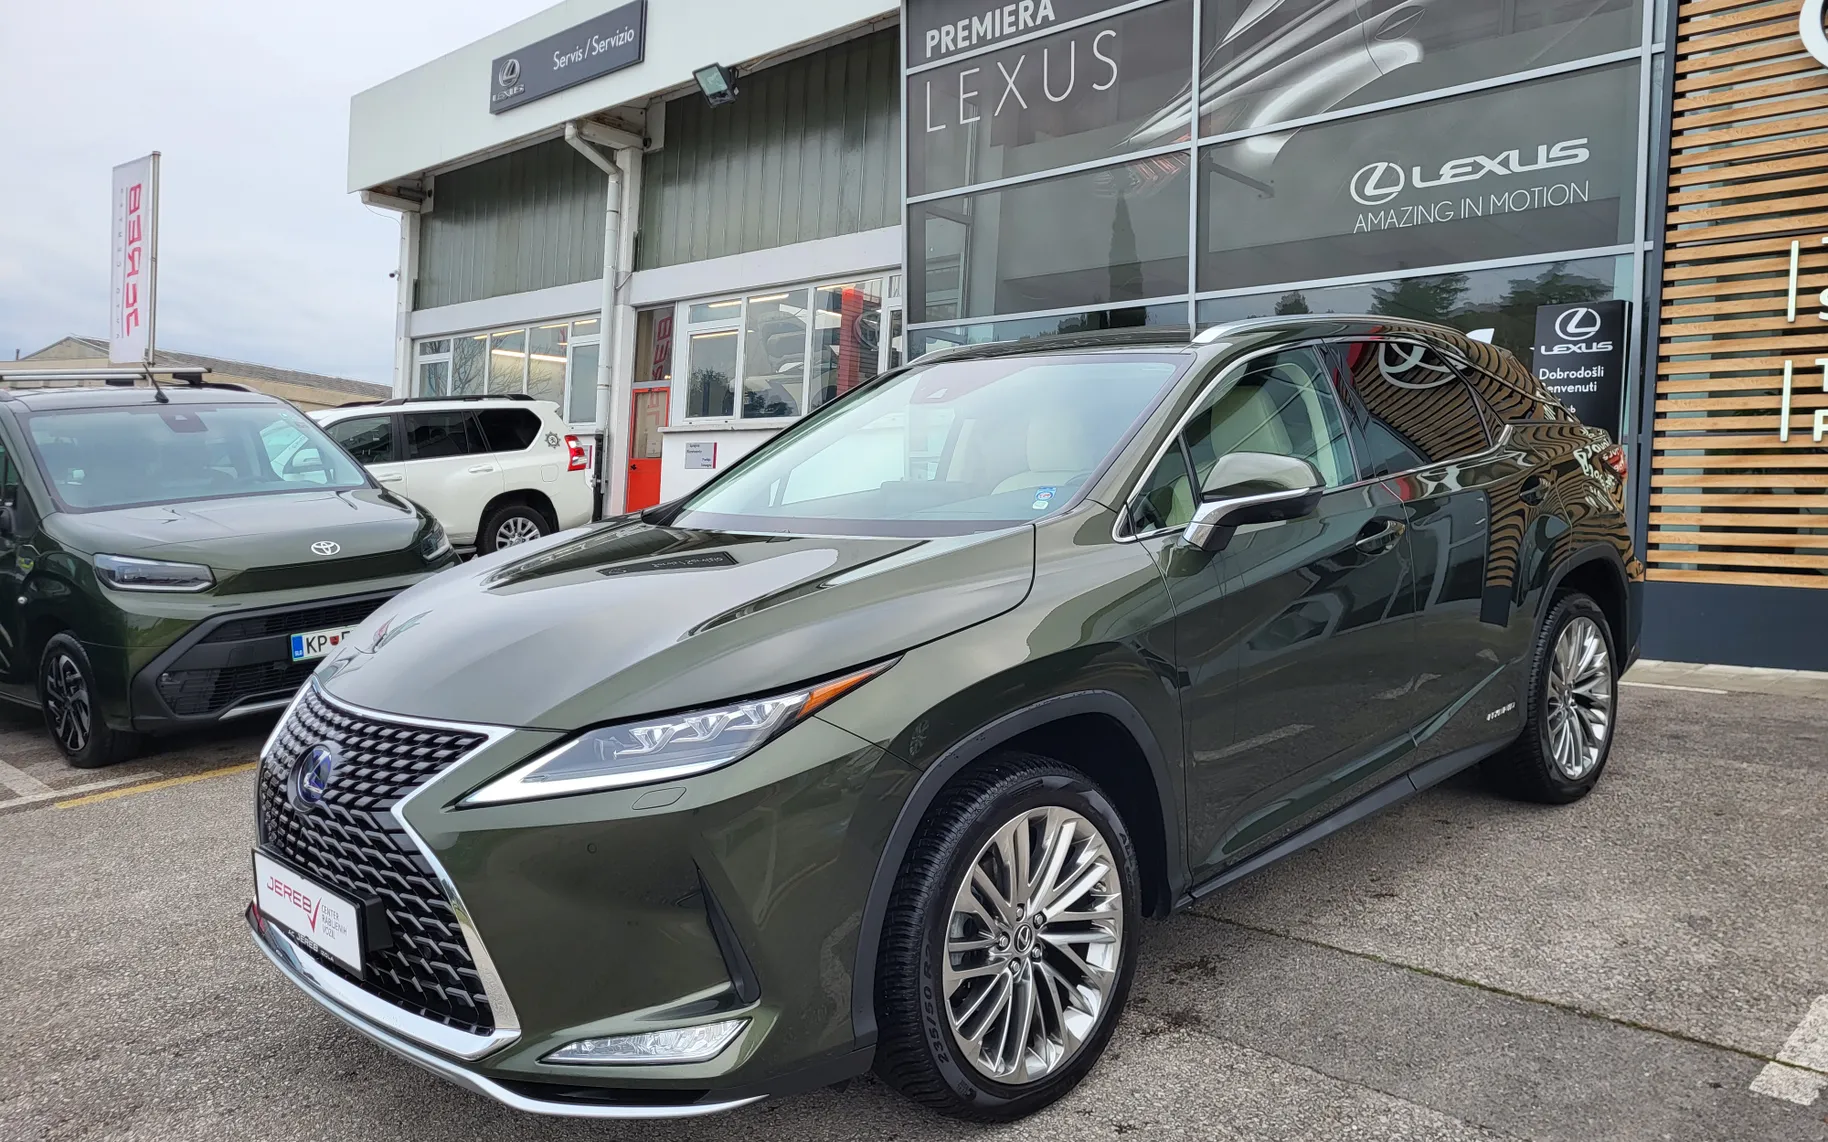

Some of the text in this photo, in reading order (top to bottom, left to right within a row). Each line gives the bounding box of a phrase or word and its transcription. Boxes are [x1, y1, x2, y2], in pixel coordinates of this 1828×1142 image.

[553, 45, 583, 70] Servis
[591, 26, 635, 56] Servizio
[925, 0, 1056, 58] PREMIERA
[492, 84, 524, 101] LEXUS
[926, 29, 1118, 132] LEXUS
[1412, 137, 1590, 189] LEXUS
[1353, 180, 1589, 234] AMAZING IN MOTION
[1540, 340, 1613, 355] LEXUS
[1539, 365, 1604, 380] Dobrodošli
[1541, 381, 1597, 394] envenuti
[305, 635, 328, 655] KP
[266, 875, 312, 914] JEREB
[296, 932, 319, 952] JEREB
[923, 985, 950, 1064] 235/50
